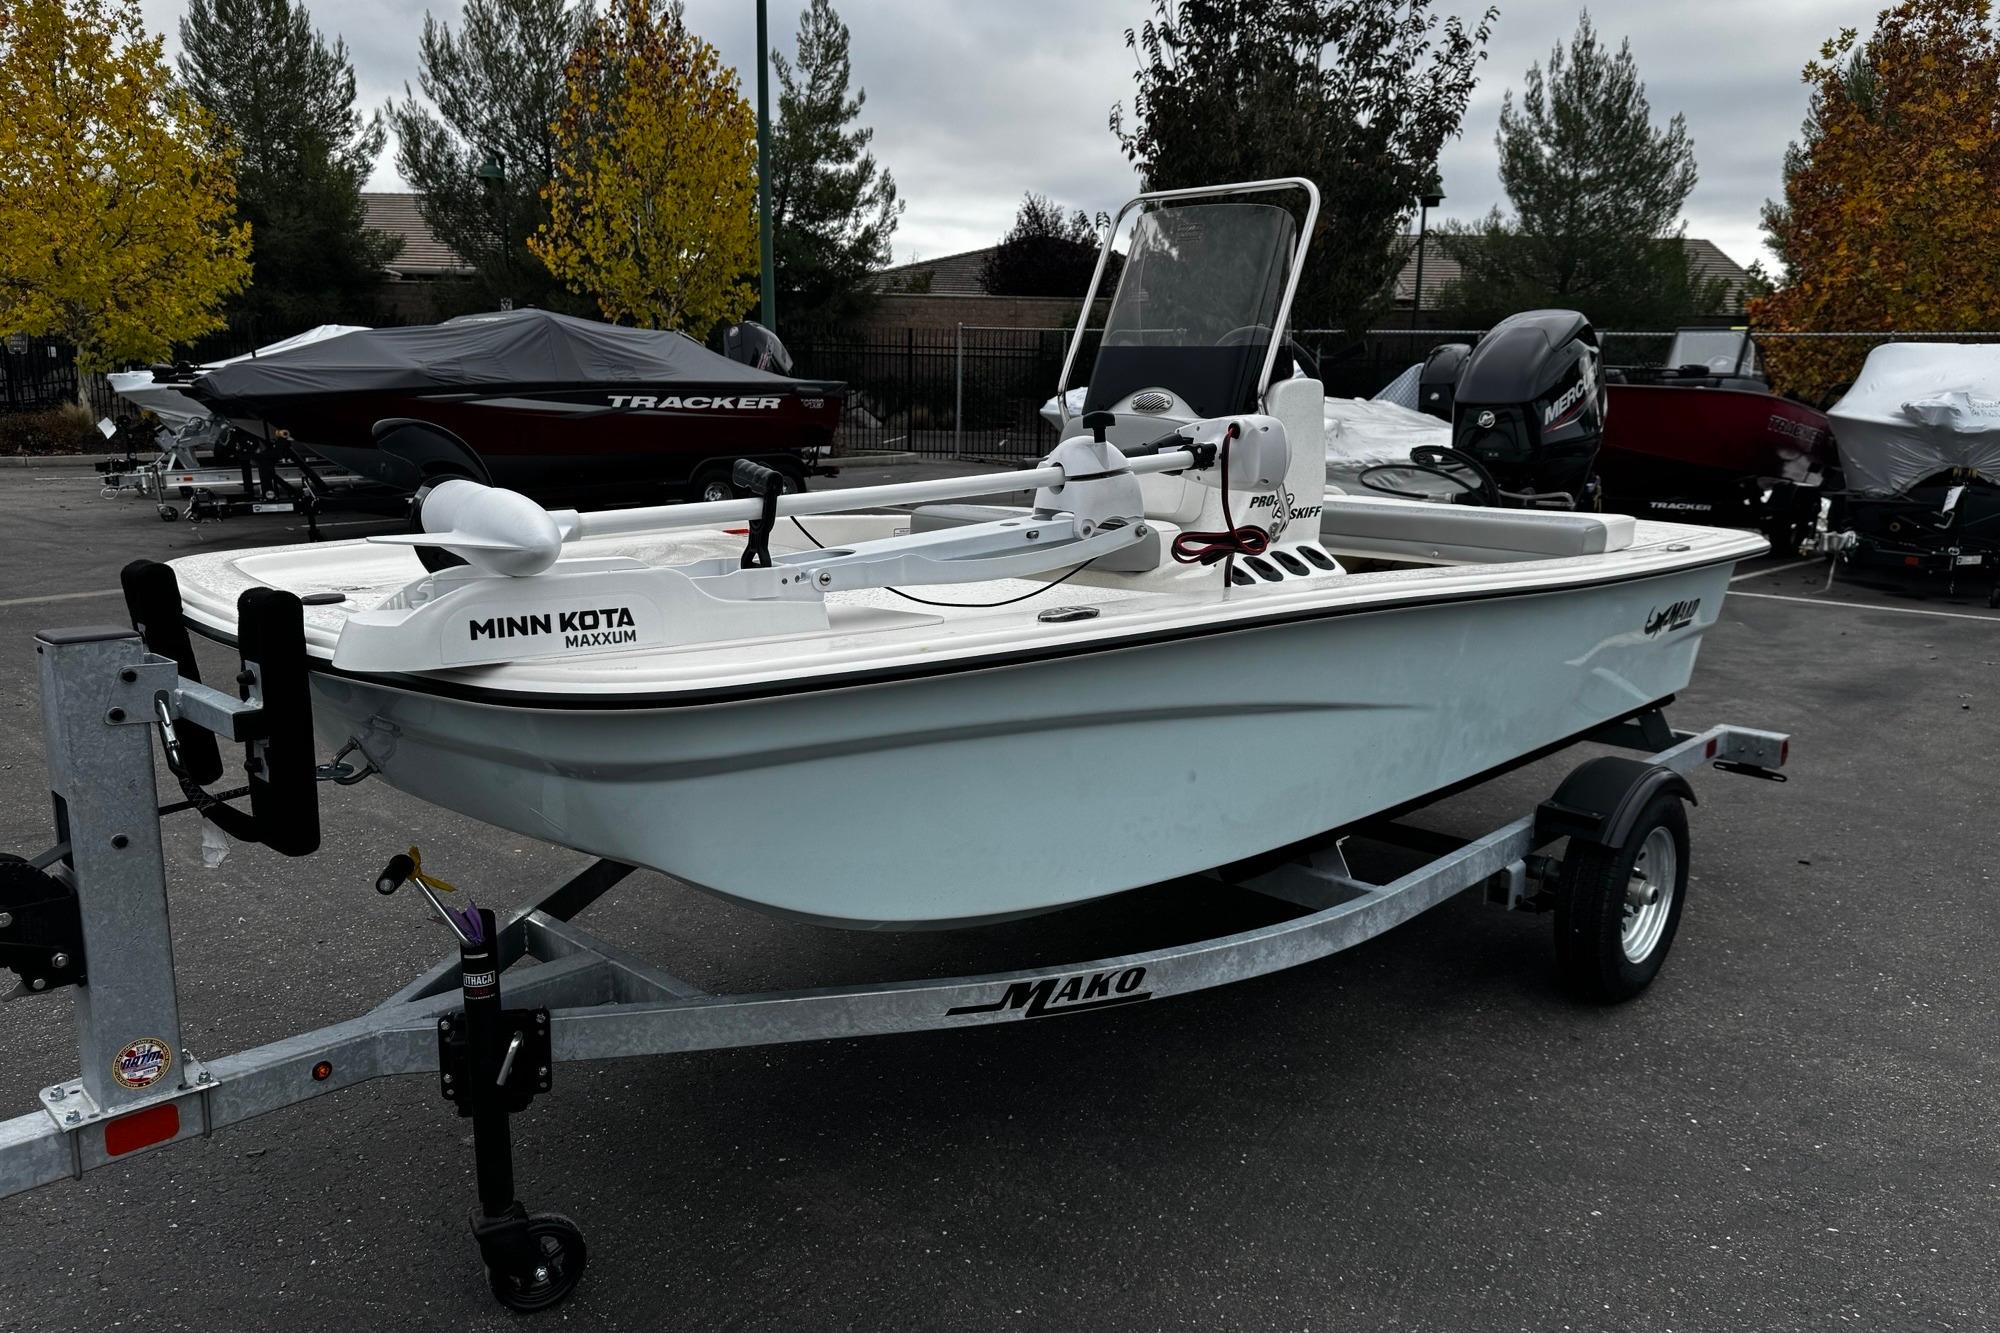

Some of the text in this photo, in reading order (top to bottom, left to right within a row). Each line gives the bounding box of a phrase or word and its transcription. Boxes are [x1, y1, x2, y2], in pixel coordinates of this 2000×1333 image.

[1544, 362, 1598, 426] MERCUR
[607, 395, 782, 409] TRACKER
[1249, 494, 1275, 509] PRO
[1648, 501, 1712, 511] TRACKER
[1289, 505, 1322, 520] SKIFF
[469, 607, 635, 641] MINN KOTA
[565, 629, 637, 649] MAXXUM
[464, 974, 493, 986] ITHACA
[999, 966, 1153, 1018] MAKO
